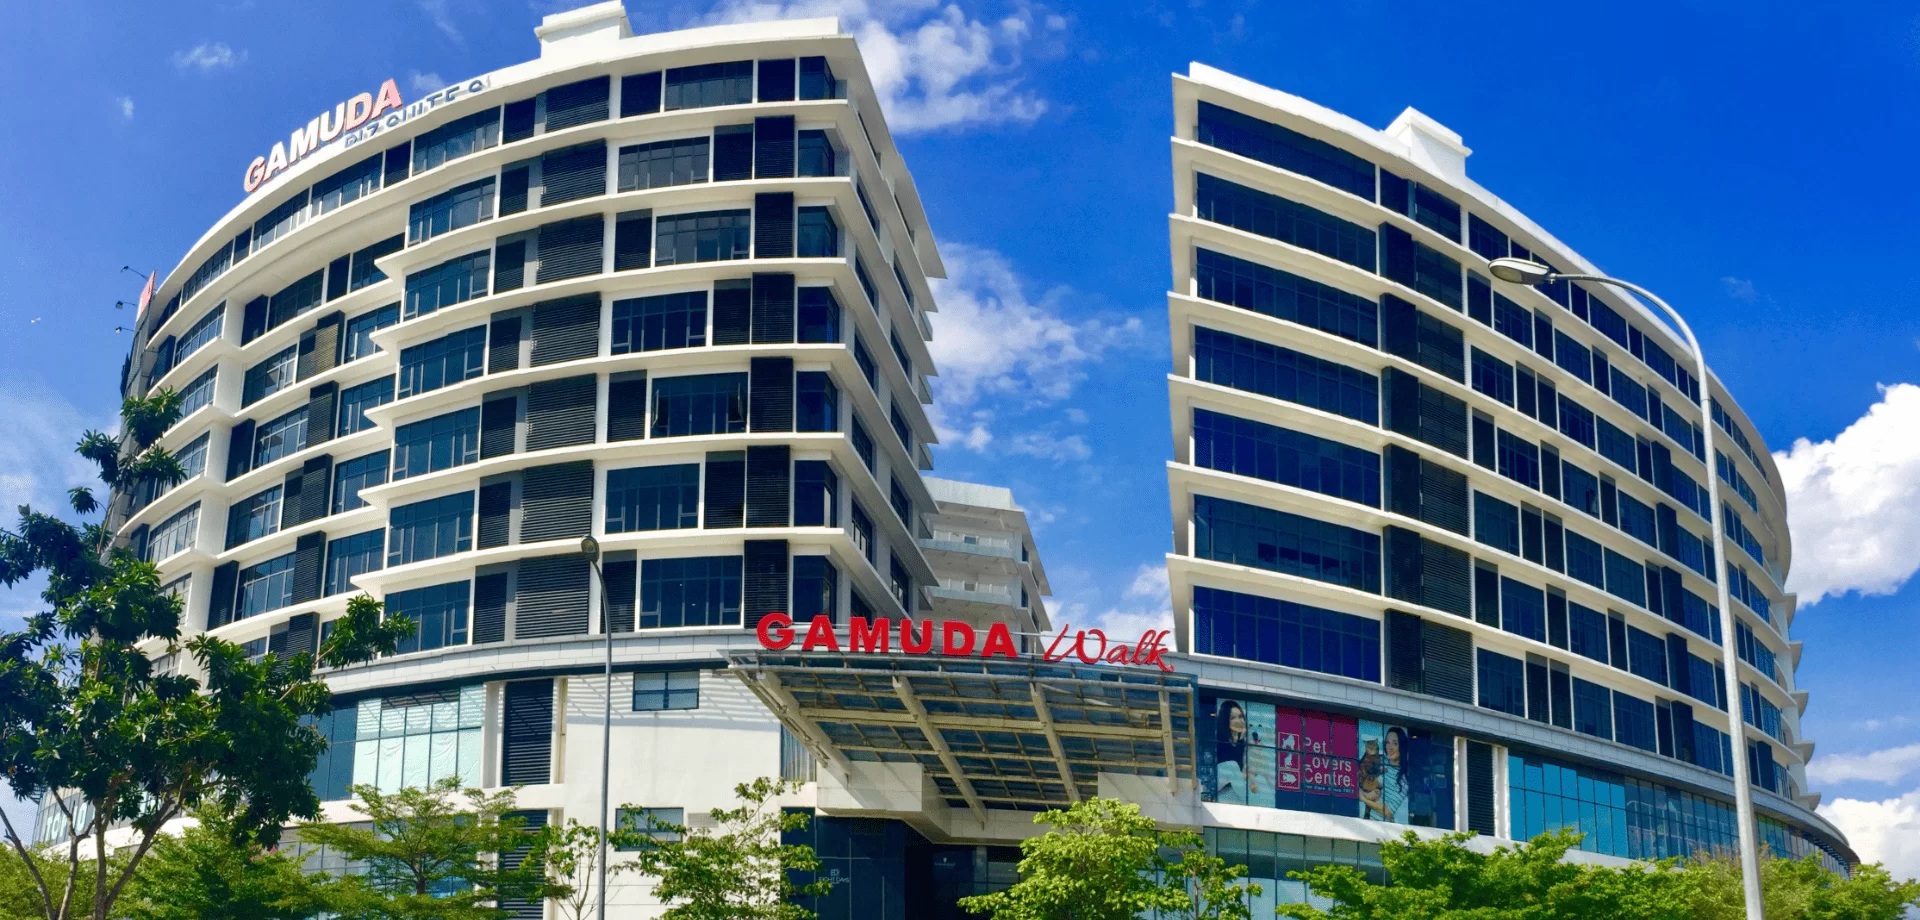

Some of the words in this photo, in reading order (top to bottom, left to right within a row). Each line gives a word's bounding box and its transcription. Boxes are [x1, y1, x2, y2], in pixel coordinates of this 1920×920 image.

[243, 78, 403, 192] GAMUDA
[756, 612, 1018, 658] GAMUDA
[1043, 623, 1175, 672] Walk
[1304, 736, 1327, 754] Pet
